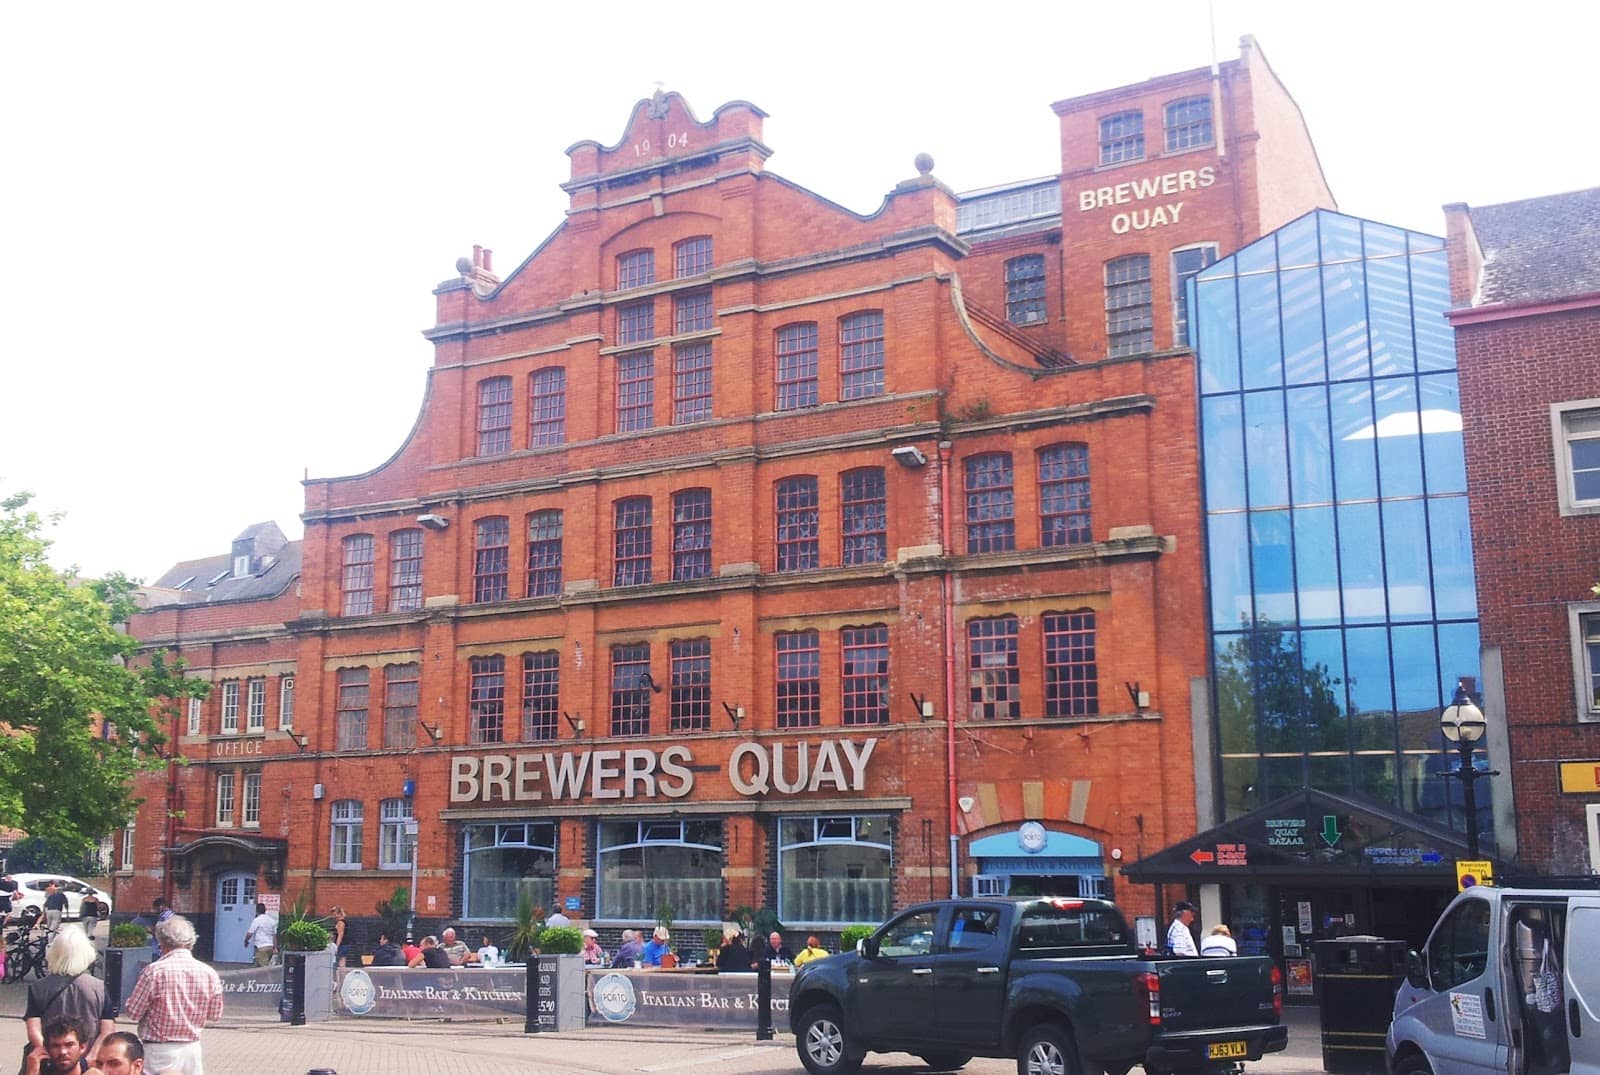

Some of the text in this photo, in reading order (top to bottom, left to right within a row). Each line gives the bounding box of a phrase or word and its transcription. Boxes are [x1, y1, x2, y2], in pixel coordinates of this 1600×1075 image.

[1079, 166, 1216, 211] BREWERS
[1111, 202, 1184, 234] QUAY
[216, 740, 263, 757] OFFICE
[449, 737, 878, 802] BREWERS QUAY
[1264, 818, 1305, 828] BREWERS
[1267, 837, 1305, 846] BAZAAR
[1273, 828, 1299, 838] QUAY
[379, 985, 522, 1002] ITALIAN BAR & KITCHEN
[602, 992, 627, 1002] PORTO
[641, 990, 696, 1008] ITALIAN
[700, 992, 730, 1009] BAR
[734, 997, 744, 1009] &
[1209, 1043, 1229, 1057] HJ63
